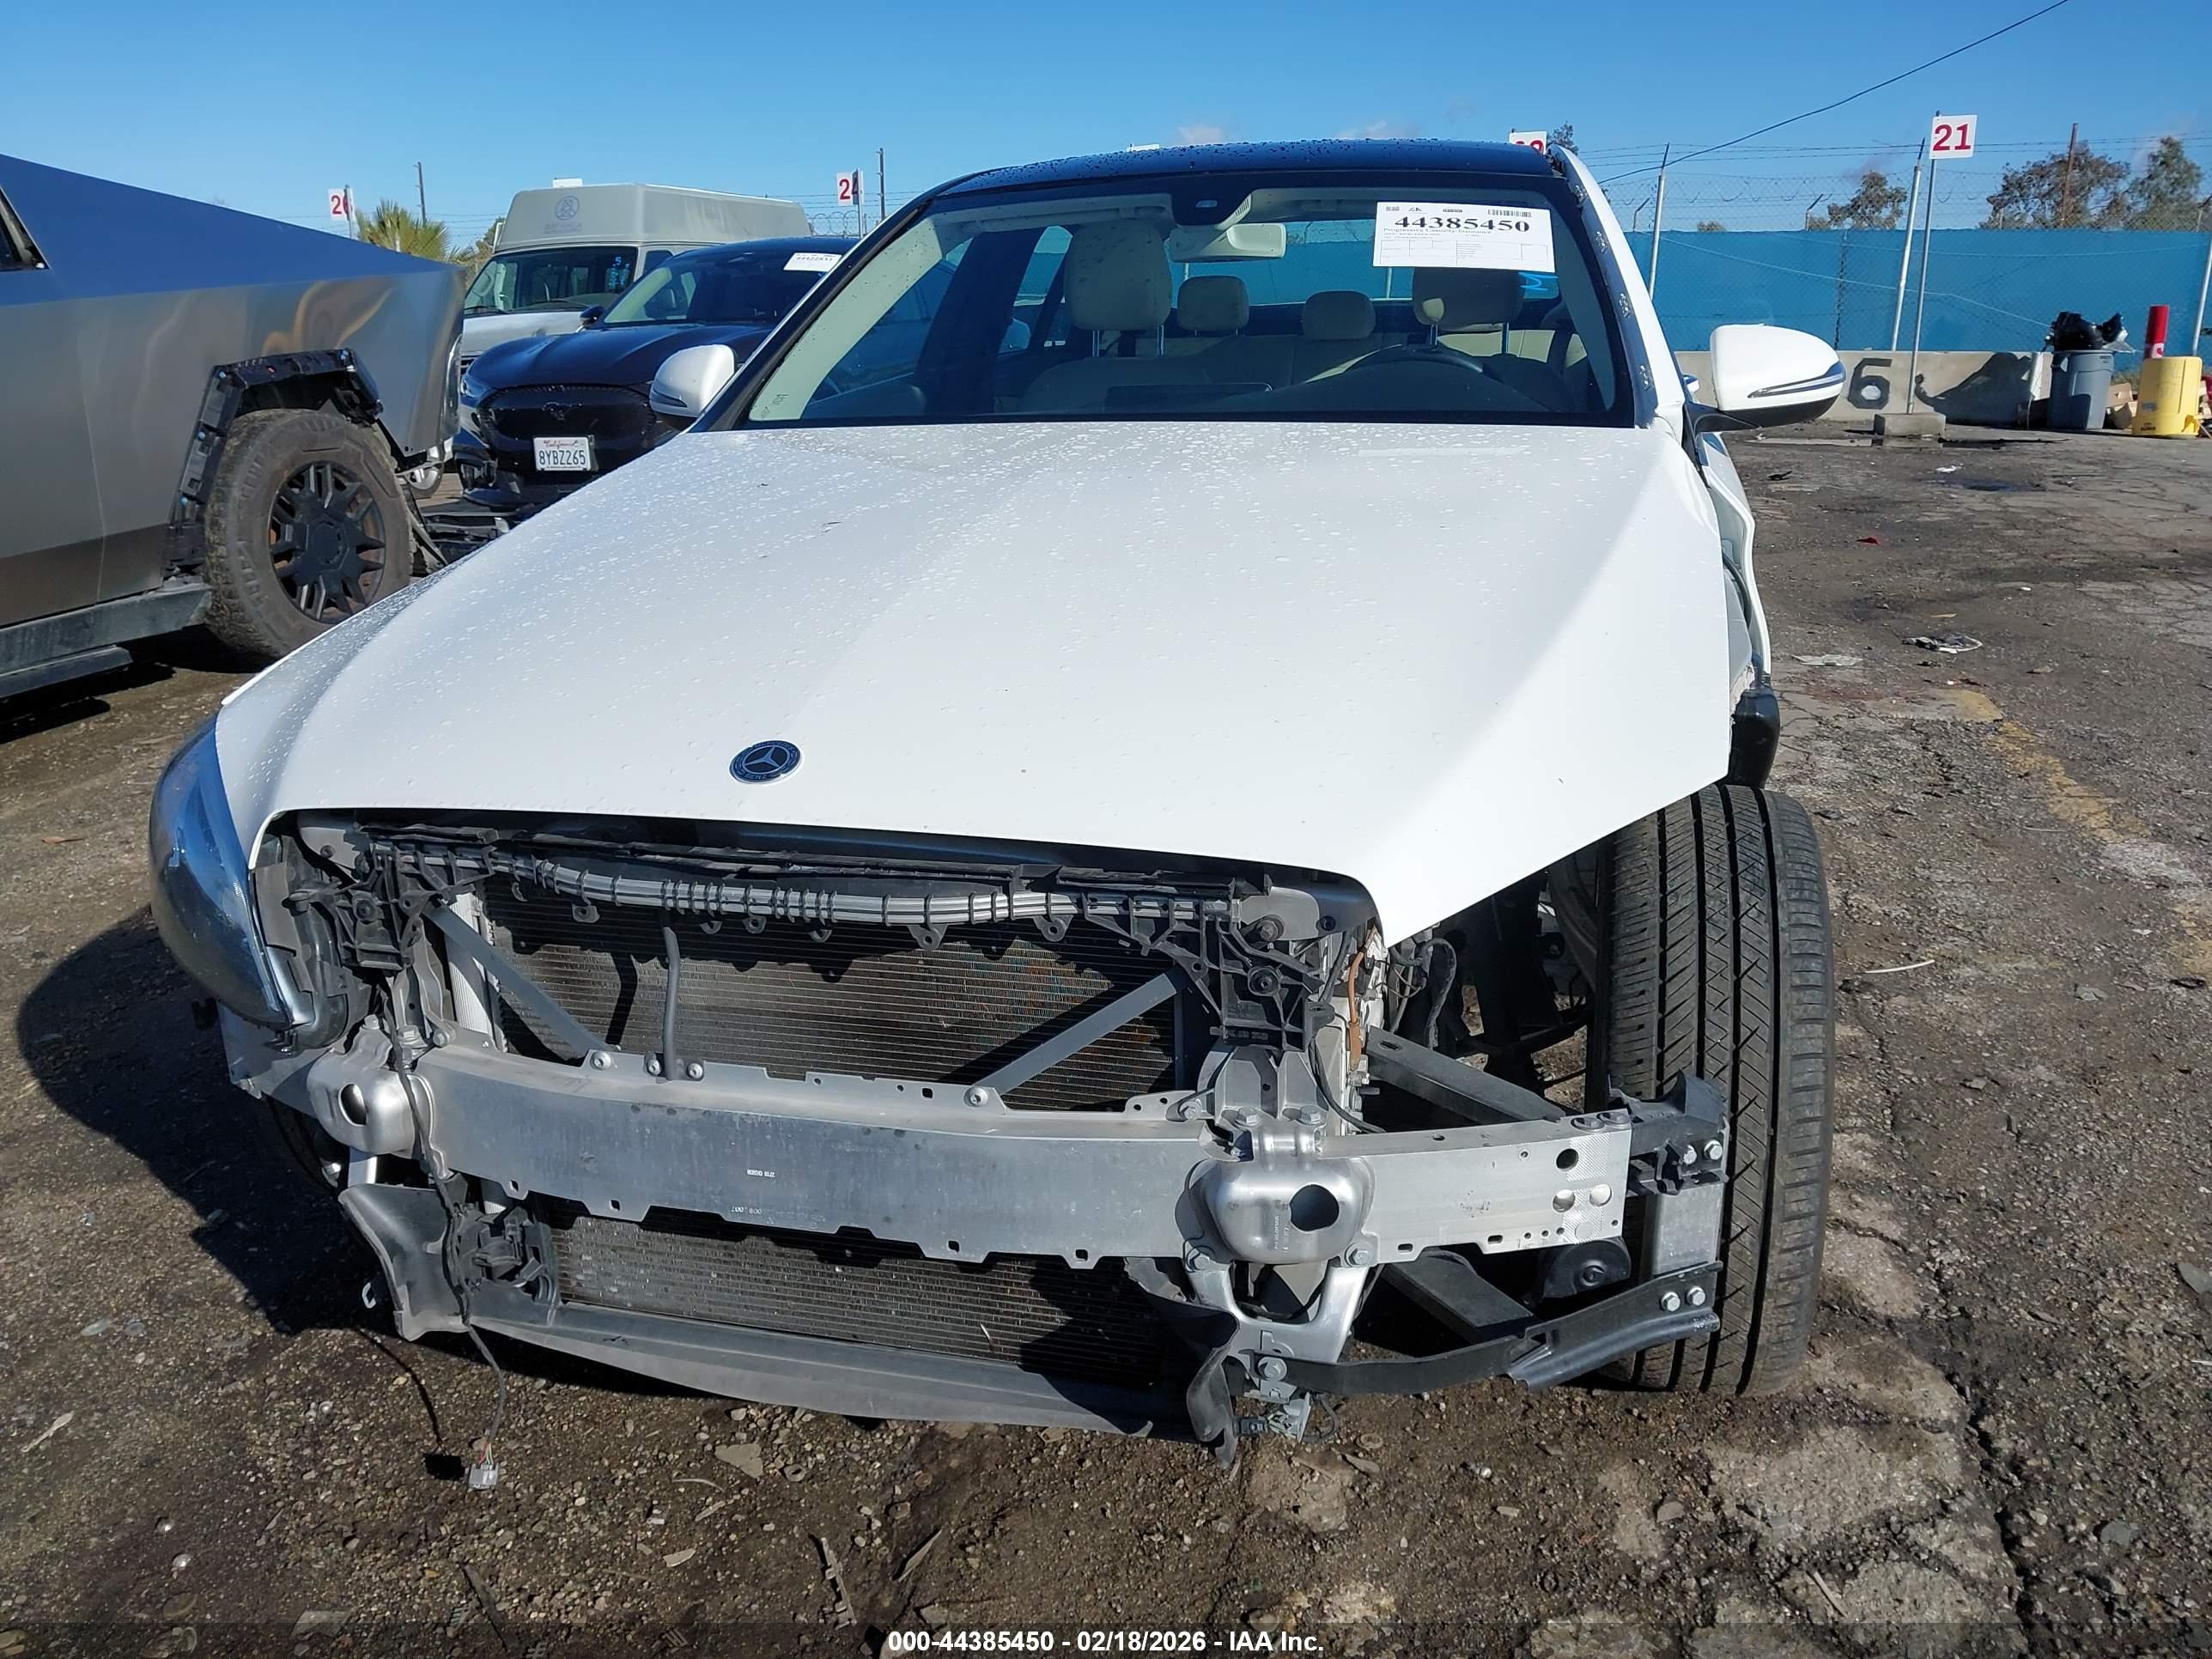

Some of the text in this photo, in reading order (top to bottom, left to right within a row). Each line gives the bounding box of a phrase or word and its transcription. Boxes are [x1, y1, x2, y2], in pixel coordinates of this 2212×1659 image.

[1933, 124, 1971, 151] 21
[1395, 216, 1530, 232] 44385450
[1848, 358, 1892, 410] 6
[539, 450, 586, 465] 8YBZ265
